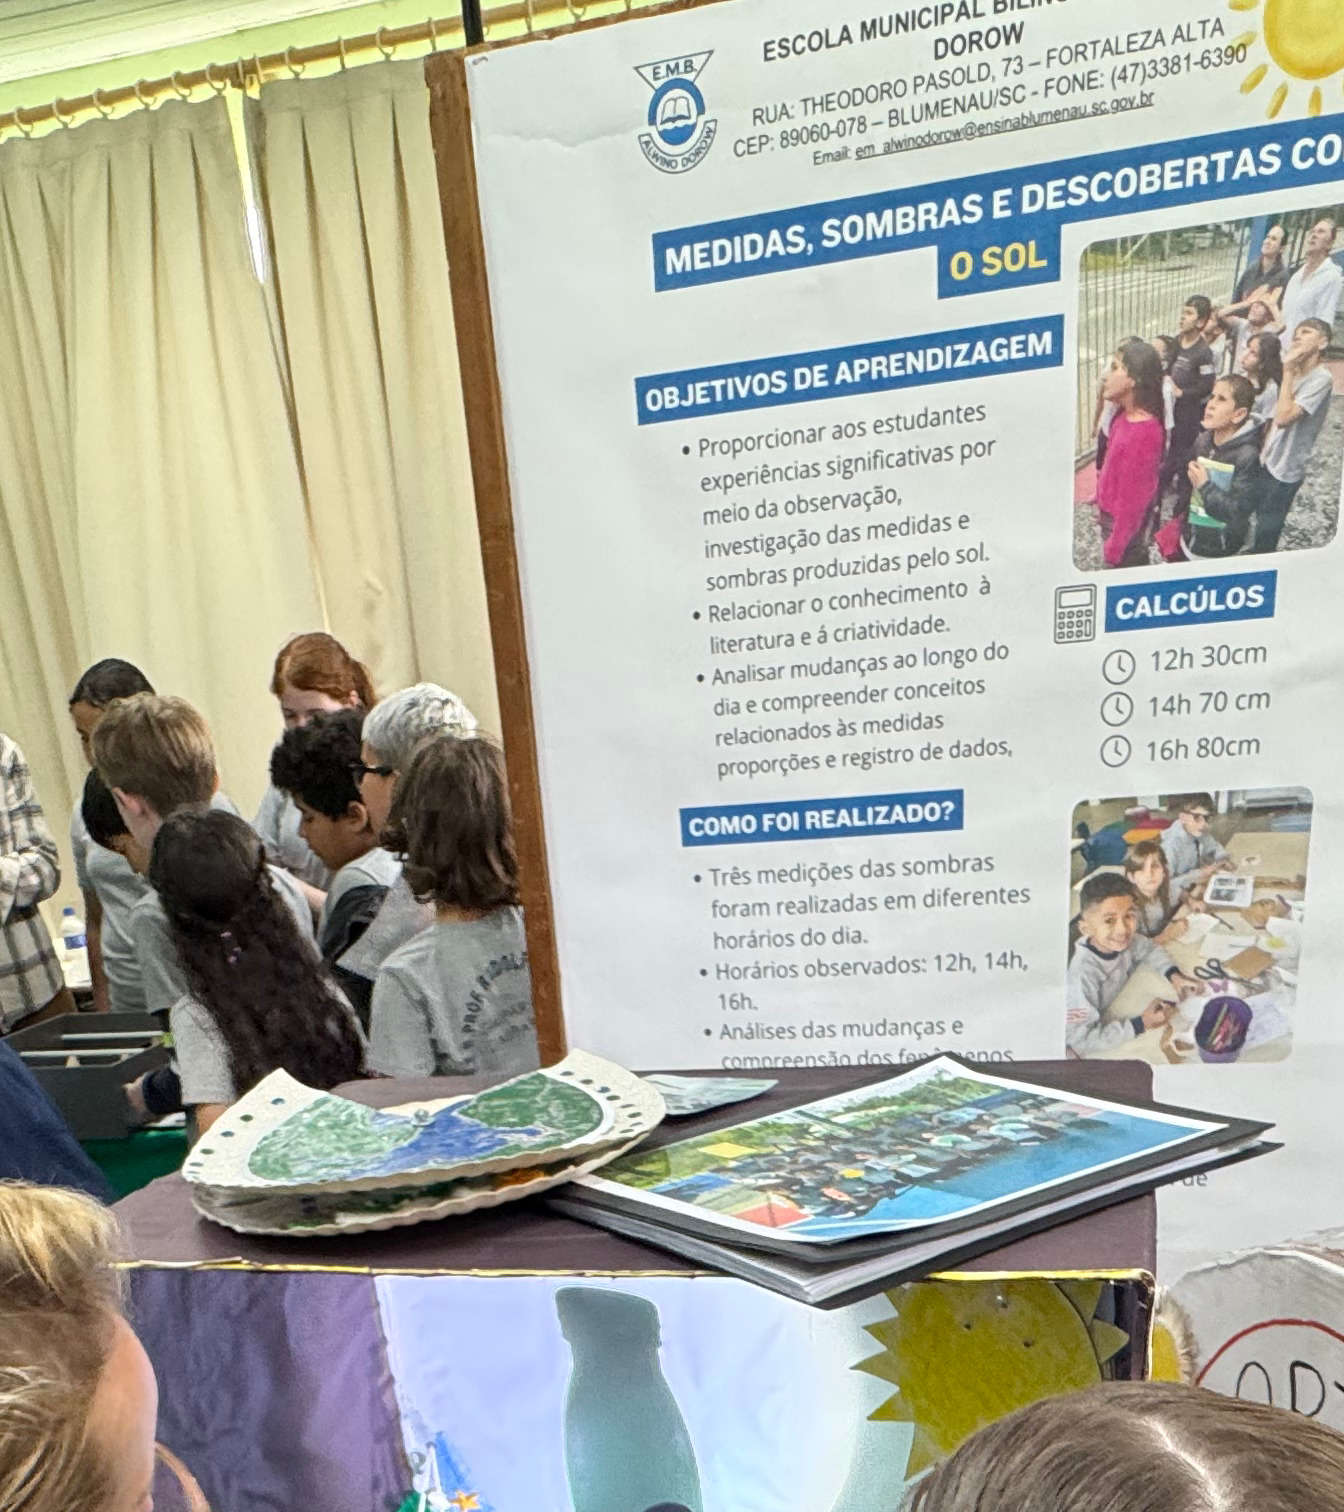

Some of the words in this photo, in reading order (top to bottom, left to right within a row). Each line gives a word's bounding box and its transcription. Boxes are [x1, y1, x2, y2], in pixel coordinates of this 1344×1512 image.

[763, 24, 853, 62] ESCOLA
[859, 0, 986, 42] MUNICIPAL
[934, 21, 1025, 60] DOROW
[752, 104, 794, 127] RUA:
[800, 78, 908, 117] THEODORO
[913, 61, 996, 95] PASOLD,
[1002, 55, 1024, 77] 73
[1046, 30, 1166, 69] FORTALEZA
[1171, 17, 1225, 46] ALTA
[733, 134, 775, 158] CEP:
[779, 115, 867, 149] 89060-078
[888, 84, 1027, 128] BLUMENAU/SC
[1044, 70, 1104, 98] FONE:
[1111, 43, 1248, 91] (47)3381-6390
[642, 139, 678, 170] ALWINO
[681, 125, 715, 168] DOROW
[813, 145, 852, 166] Email:
[666, 225, 813, 274] MEDIDAS,
[822, 194, 983, 247] SOMBRAS
[993, 188, 1012, 218] E
[1022, 143, 1281, 213] DESCOBERTAS
[949, 249, 974, 282] O
[983, 239, 1048, 278] SOL
[646, 371, 787, 411] OBJETIVOS
[794, 364, 828, 390] DE
[835, 331, 1052, 384] APRENDIZAGEM
[699, 426, 827, 460] Proporcionar
[832, 421, 867, 440] aos
[873, 405, 986, 435] estudantes
[701, 460, 821, 495] experiências
[826, 445, 954, 480] significativas
[960, 440, 996, 465] por
[703, 503, 750, 525] meio
[755, 498, 778, 519] da
[784, 485, 902, 515] observação,
[705, 529, 821, 558] investigação
[826, 524, 861, 544] das
[867, 514, 952, 540] medidas
[958, 515, 970, 529] e
[706, 567, 787, 591] sombras
[793, 552, 901, 587] produzidas
[907, 547, 950, 575] pelo
[956, 542, 990, 564] sol.
[709, 599, 806, 623] Relacionar
[811, 598, 823, 613] o
[828, 581, 968, 611] conhecimento
[979, 575, 990, 595] à
[1116, 585, 1264, 619] CALCÚLOS
[710, 633, 794, 654] literatura
[801, 632, 811, 646] e
[817, 624, 827, 644] á
[833, 614, 950, 643] criatividade.
[712, 664, 785, 685] Analisar
[791, 656, 888, 678] mudanças
[893, 654, 917, 669] ao
[923, 647, 977, 669] longo
[984, 641, 1009, 661] do
[1151, 647, 1193, 671] 12h
[1201, 645, 1267, 667] 30cm
[713, 698, 741, 716] dia
[746, 700, 757, 713] e
[762, 685, 889, 714] compreender
[894, 677, 985, 701] conceitos
[1149, 693, 1191, 717] 14h
[1199, 691, 1228, 713] 70
[1235, 692, 1270, 711] cm
[715, 721, 831, 746] relacionados
[836, 718, 857, 737] às
[863, 712, 944, 734] medidas
[1147, 739, 1188, 761] 16h
[1196, 736, 1260, 758] 80cm
[718, 753, 820, 781] proporções
[825, 755, 836, 768] e
[842, 747, 914, 771] registro
[920, 742, 943, 761] de
[689, 815, 757, 836] COMO
[763, 812, 799, 832] FOI
[805, 801, 954, 829] REALIZADO?
[708, 866, 752, 887] Três
[757, 862, 853, 887] medições
[860, 858, 896, 878] das
[902, 853, 994, 876] sombras
[712, 899, 770, 918] foram
[777, 893, 878, 915] realizadas
[884, 895, 916, 910] em
[923, 887, 1031, 908] diferentes
[713, 929, 795, 949] horários
[800, 927, 826, 947] do
[832, 926, 868, 945] dia.
[716, 957, 801, 981] Horários
[804, 956, 928, 977] observados:
[934, 952, 977, 975] 12h,
[985, 950, 1028, 971] 14h,
[718, 992, 758, 1011] 16h.
[720, 1022, 796, 1040] Análises
[802, 1021, 837, 1039] das
[843, 1018, 945, 1041] mudanças
[952, 1020, 963, 1035] e
[857, 1048, 893, 1066] dos
[899, 1047, 1014, 1063] fenenos
